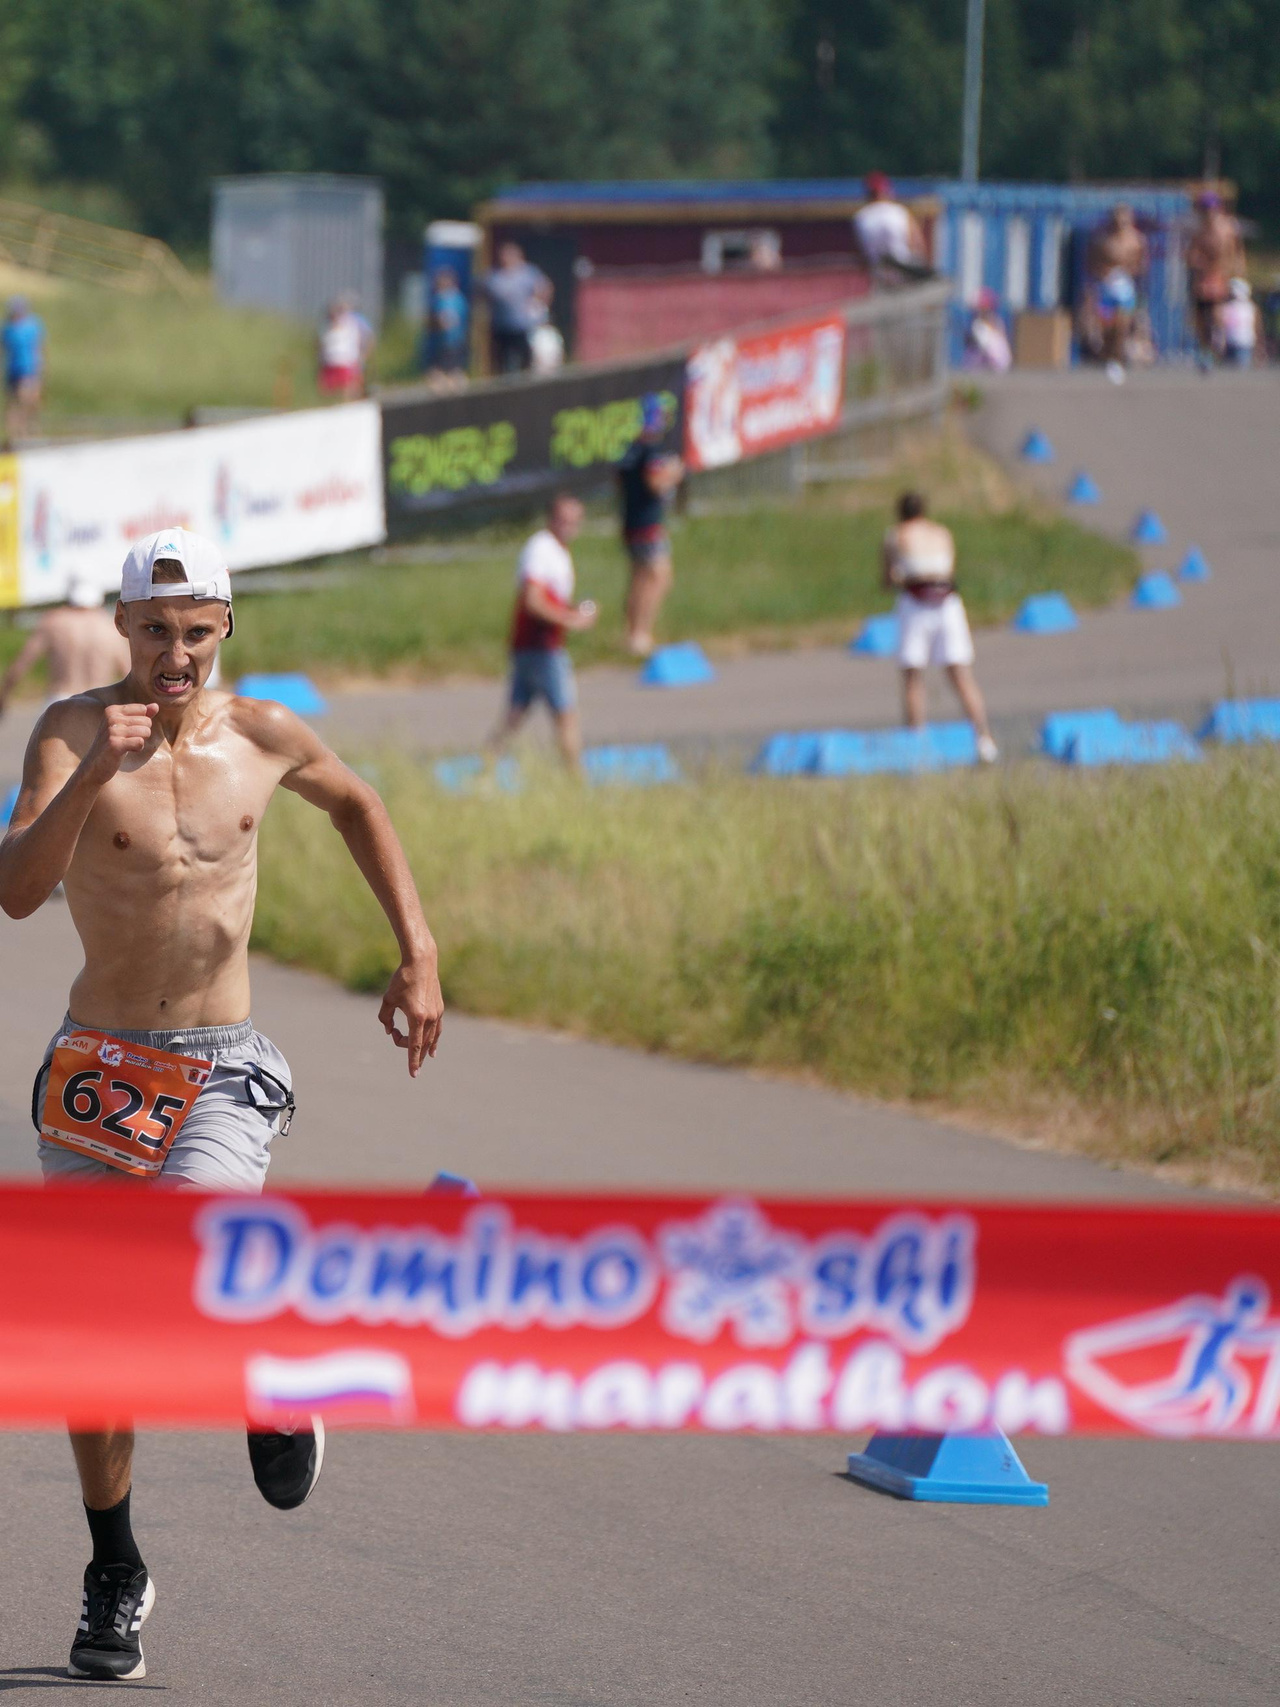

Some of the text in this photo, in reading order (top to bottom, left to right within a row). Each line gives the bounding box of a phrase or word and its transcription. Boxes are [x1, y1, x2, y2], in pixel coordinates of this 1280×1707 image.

[60, 1037, 69, 1047] 3
[62, 1070, 187, 1149] 625
[458, 1340, 1068, 1434] marathon
